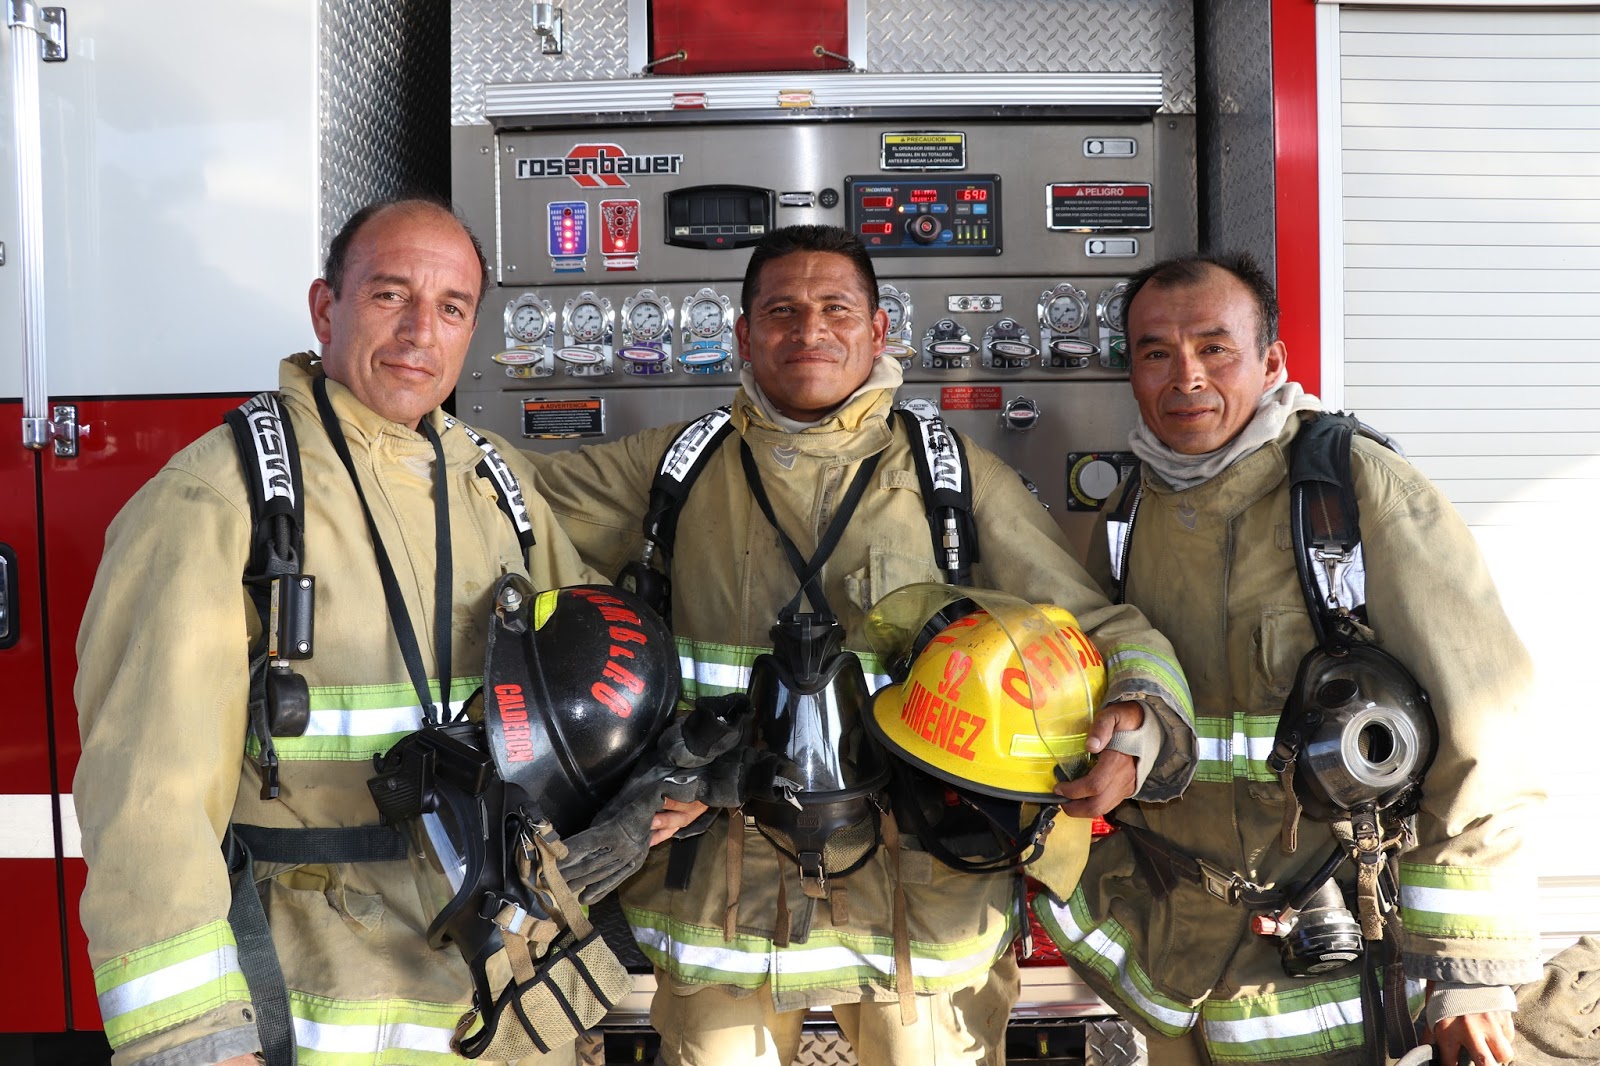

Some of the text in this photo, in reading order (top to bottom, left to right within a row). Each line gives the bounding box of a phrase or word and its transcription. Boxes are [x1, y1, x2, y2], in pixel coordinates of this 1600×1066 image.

[517, 149, 682, 177] rosenbauer
[886, 196, 894, 207] 0
[964, 190, 987, 200] 690
[1085, 188, 1124, 196] PELIGRO
[885, 223, 892, 233] 0
[254, 416, 291, 494] MSA
[938, 650, 973, 703] 92
[494, 683, 534, 763] CALDERON
[900, 680, 986, 762] JIMENEZ
